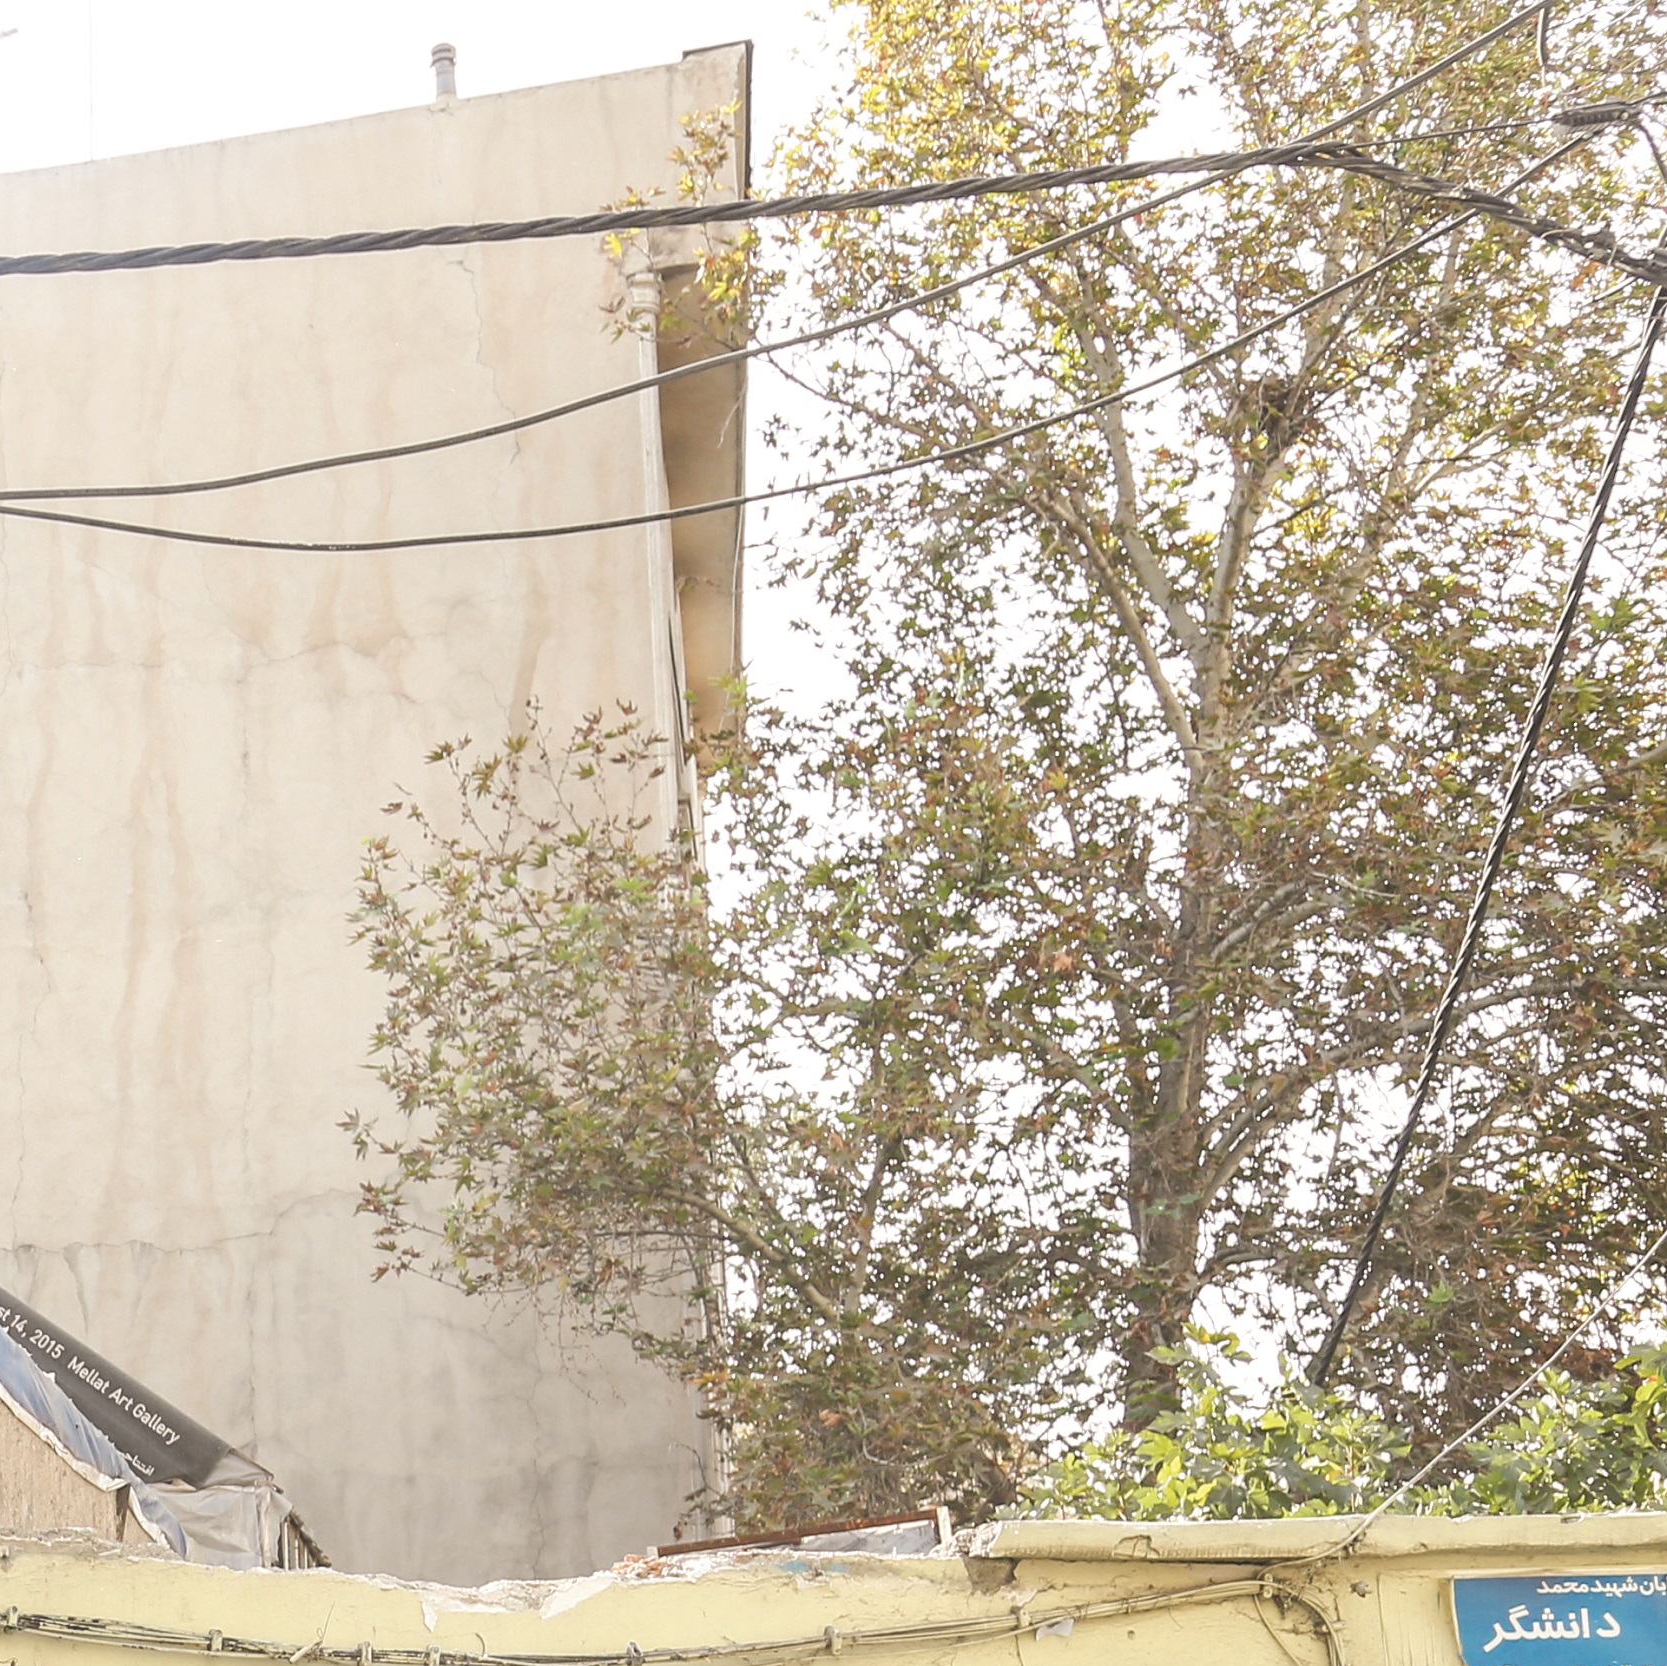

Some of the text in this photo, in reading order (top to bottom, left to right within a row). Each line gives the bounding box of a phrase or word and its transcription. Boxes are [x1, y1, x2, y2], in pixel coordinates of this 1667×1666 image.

[29, 1329, 65, 1359] 2015
[67, 1356, 110, 1393] Mellat
[108, 1388, 133, 1411] Art
[132, 1403, 181, 1445] Gallery
[1536, 1580, 1590, 1594] محمد
[1590, 1576, 1638, 1598] شهید
[1483, 1604, 1622, 1653] دانشگر
